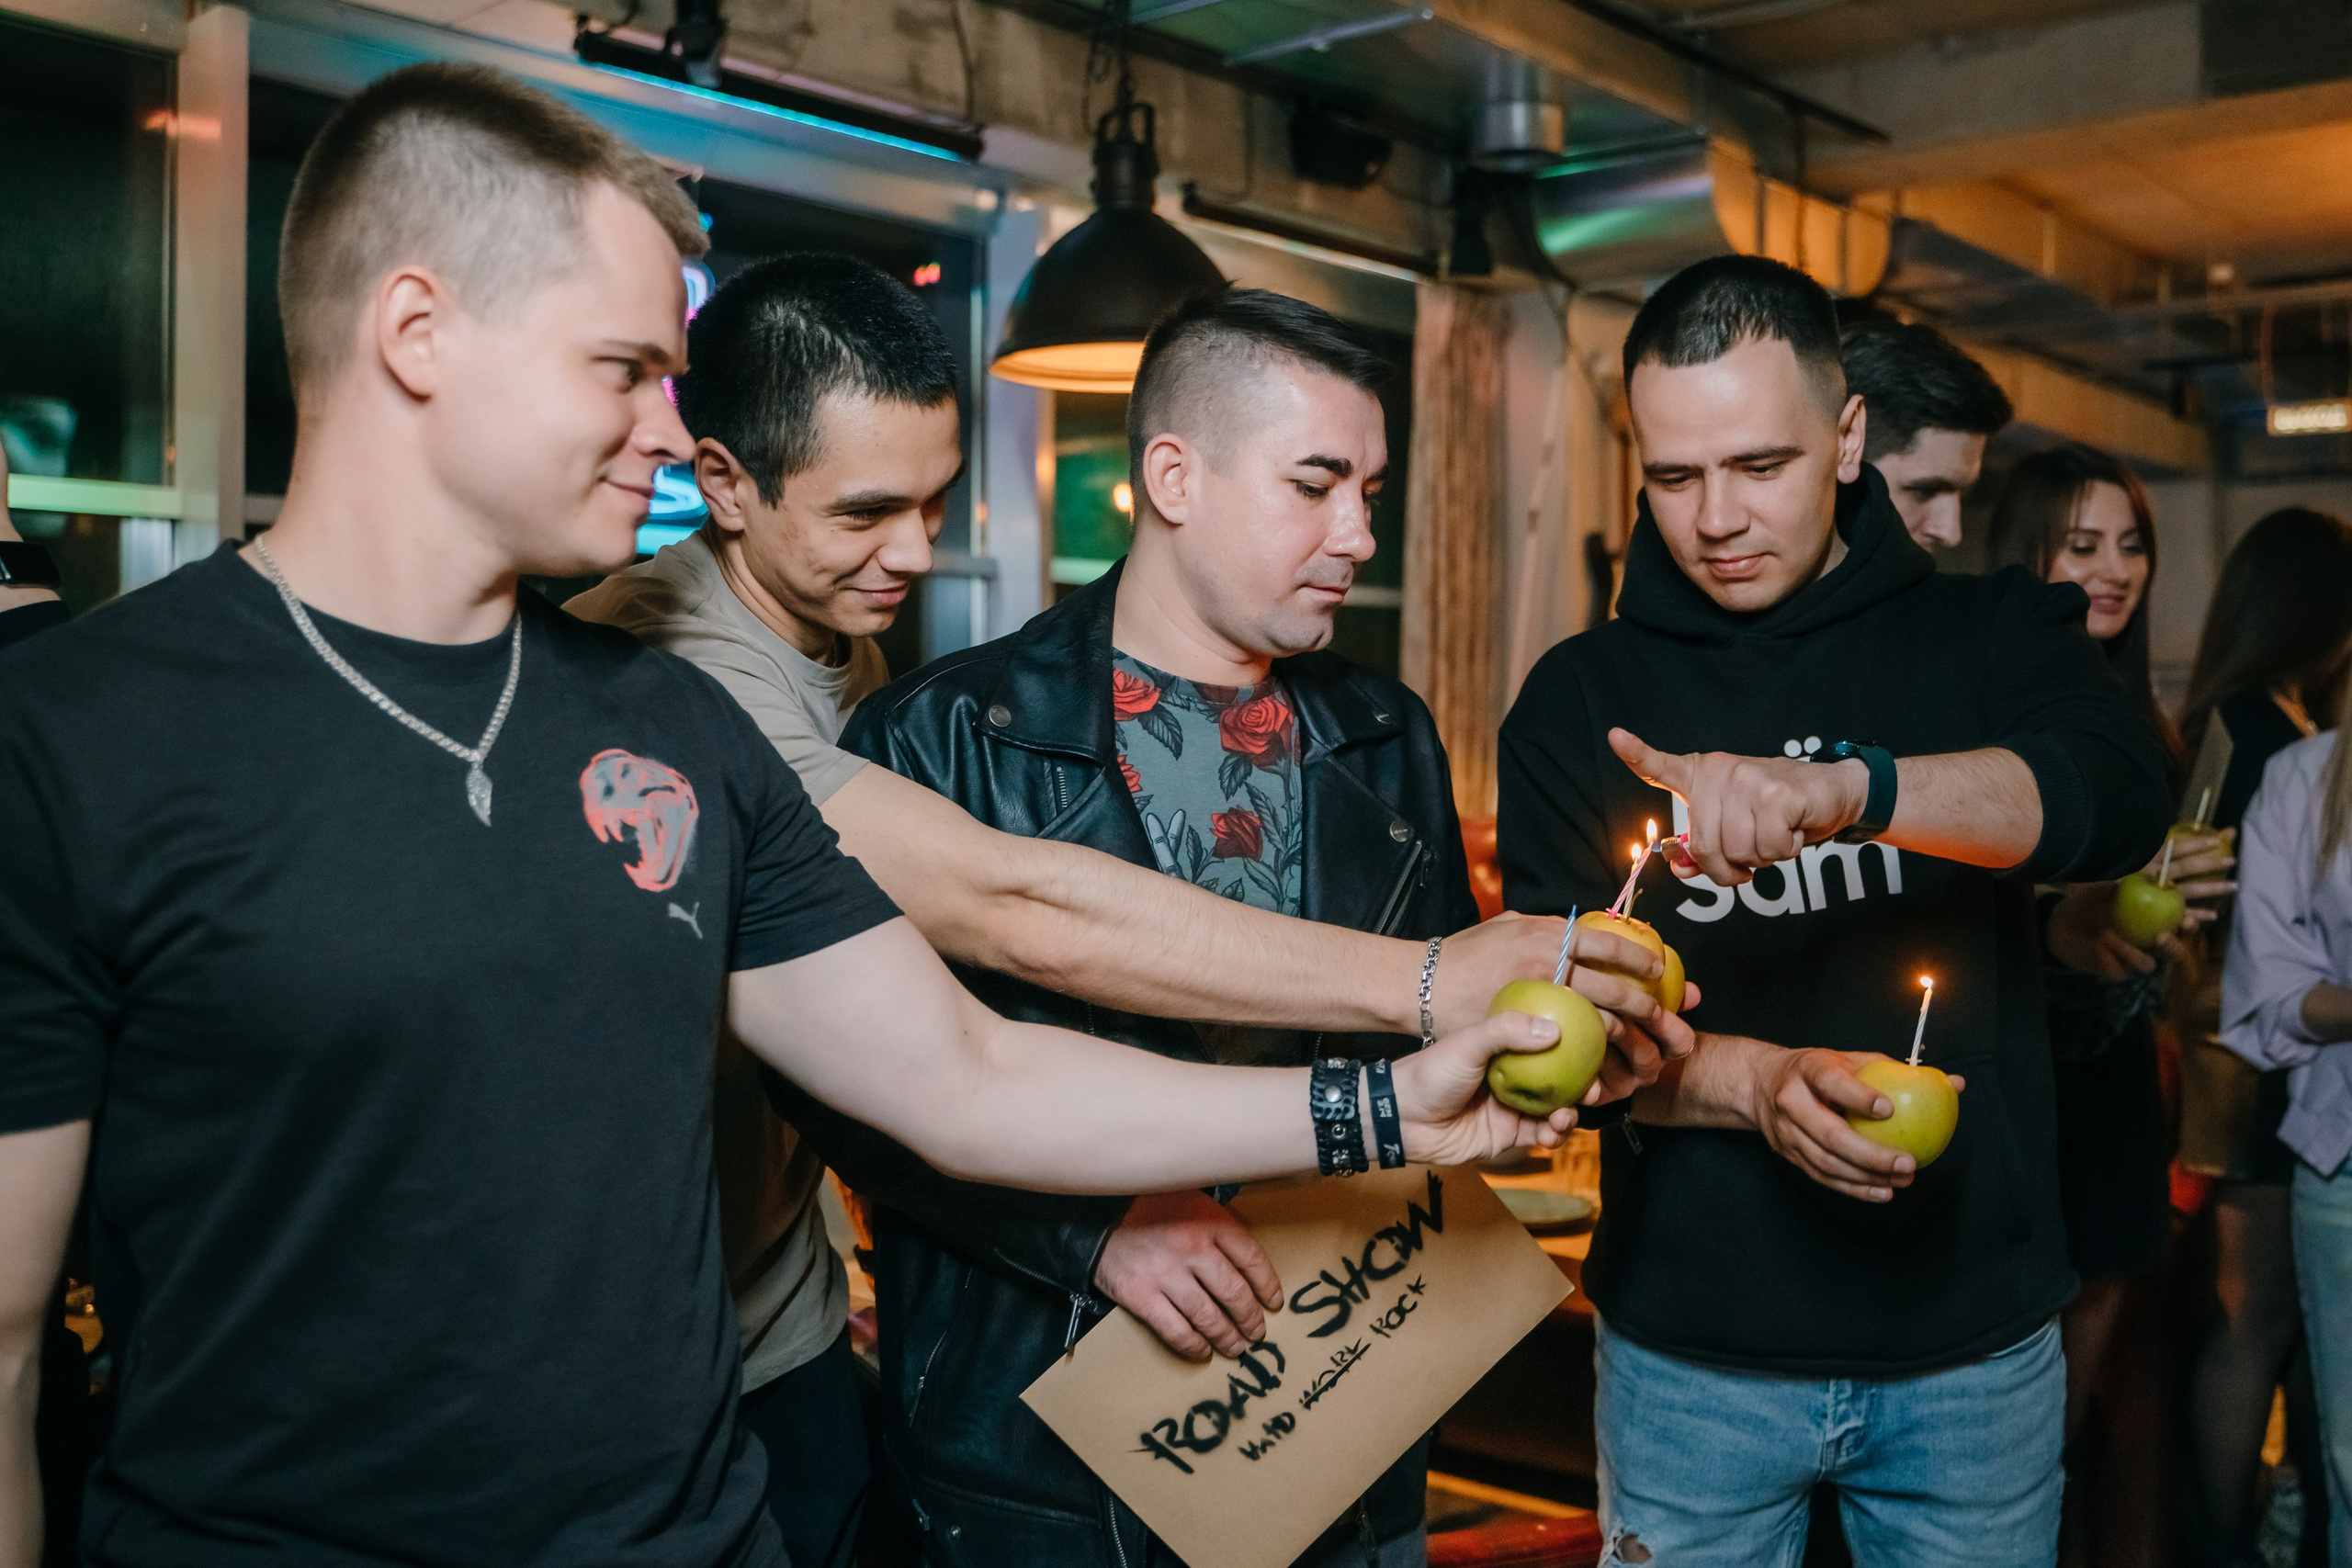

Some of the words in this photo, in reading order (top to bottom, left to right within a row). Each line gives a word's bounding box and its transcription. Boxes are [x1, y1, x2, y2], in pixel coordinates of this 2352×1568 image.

[1135, 1342, 1286, 1474] ROAD
[1289, 1169, 1444, 1338] SHOW
[1369, 1274, 1426, 1338] ROCK
